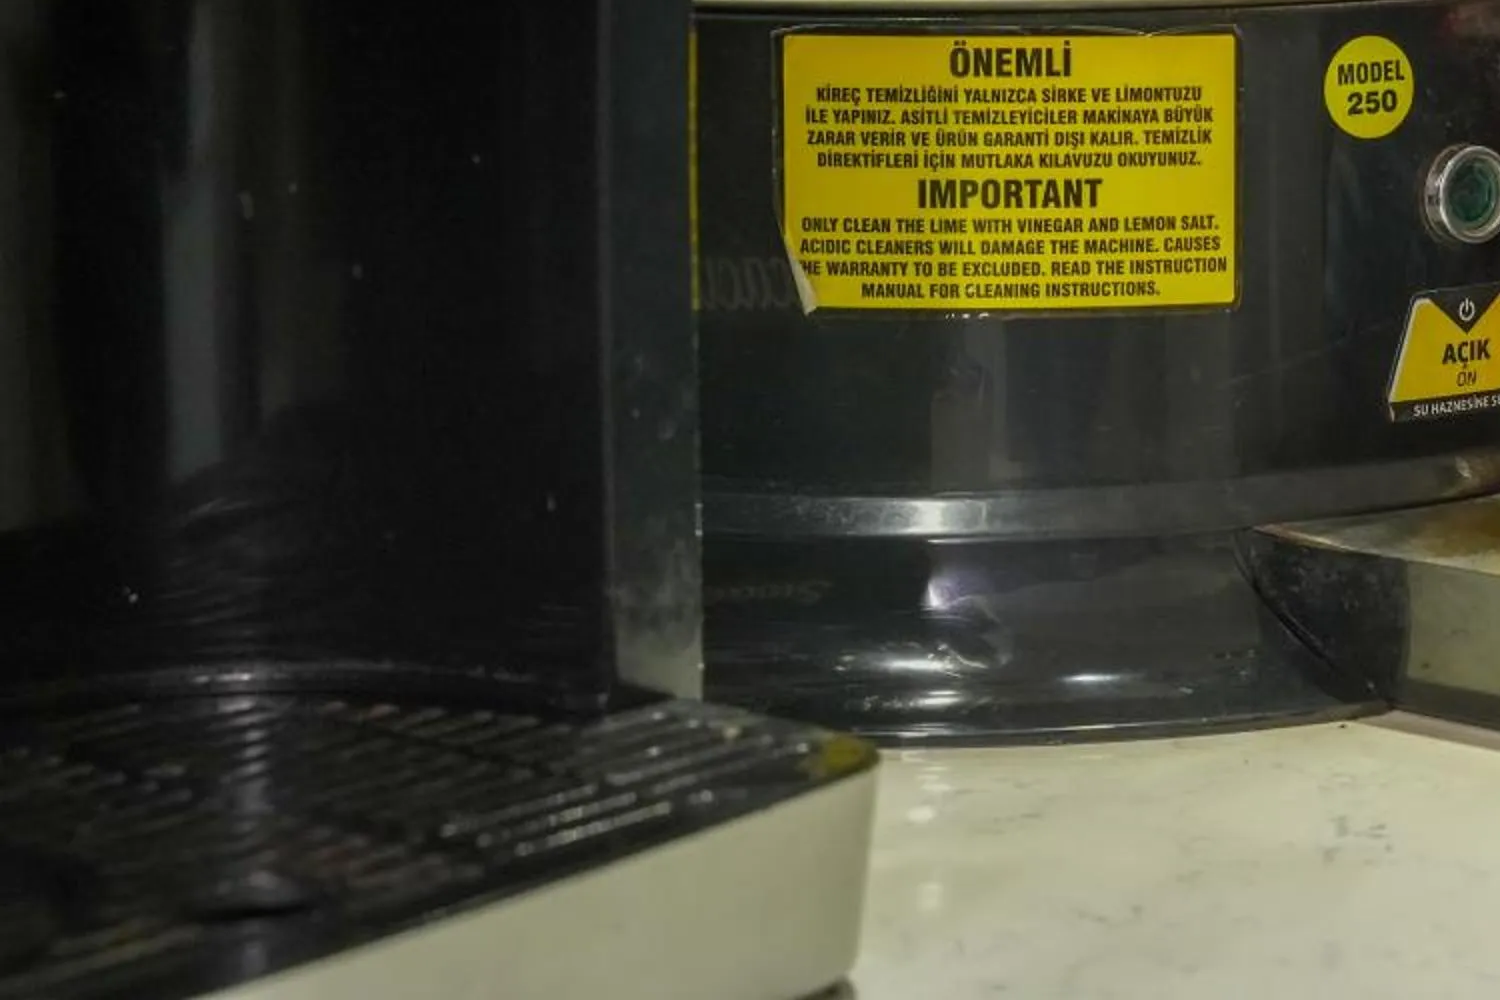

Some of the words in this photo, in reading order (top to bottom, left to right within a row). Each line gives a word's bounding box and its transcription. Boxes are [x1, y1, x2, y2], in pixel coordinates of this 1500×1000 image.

[949, 40, 1072, 78] ÖNEMLİ
[1337, 59, 1405, 86] MODEL
[816, 83, 861, 106] KİREÇ
[865, 84, 959, 103] TEMİZLİĞİNİ
[963, 88, 1037, 104] YALNIZCA
[1041, 84, 1087, 103] SİRKE
[1091, 87, 1111, 103] VE
[1115, 84, 1203, 102] LİMONTUZU
[1346, 88, 1398, 116] 250
[805, 105, 828, 124] İLE
[832, 109, 896, 125] YAPINIZ.
[900, 107, 948, 125] ASİTLİ
[952, 107, 1078, 125] TEMİZLEYİCİLER
[1083, 106, 1159, 124] MAKİNAYA
[1163, 104, 1214, 124] BÜYÜK
[807, 130, 856, 146] ZARAR
[860, 128, 906, 146] VERİR
[910, 131, 931, 146] VE
[935, 128, 978, 147] ÜRÜN
[983, 128, 1049, 147] GARANTİ
[1054, 130, 1085, 149] DIŞI
[1089, 131, 1139, 146] KALIR.
[1143, 127, 1213, 145] TEMİZLİK
[817, 150, 919, 169] DİREKTİFLERİ
[923, 150, 956, 172] İÇİN
[961, 153, 1034, 169] MUTLAKA
[1039, 152, 1113, 168] KILAVUZU
[1117, 151, 1203, 167] OKUYUNUZ.
[917, 178, 1104, 209] IMPORTANT
[801, 217, 838, 233] ONLY
[843, 217, 891, 233] CLEAN
[896, 218, 925, 233] THE
[930, 218, 968, 233] LIME
[972, 218, 1013, 233] WITH
[1017, 217, 1084, 233] VINEGAR
[1088, 217, 1119, 233] AND
[1123, 216, 1177, 232] LEMON
[1180, 214, 1220, 231] SALT.
[800, 238, 851, 255] ACIDIC
[855, 239, 934, 255] CLEANERS
[938, 239, 976, 255] WILL
[980, 239, 1045, 255] DAMAGE
[1049, 239, 1079, 254] THE
[1083, 238, 1160, 254] MACHINE.
[1163, 236, 1221, 252] CAUSES
[825, 260, 909, 276] WARRANTY
[913, 261, 933, 276] TO
[937, 261, 957, 276] BE
[962, 260, 1046, 277] EXCLUDED.
[1050, 260, 1092, 276] READ
[1096, 259, 1125, 275] THE
[1129, 257, 1228, 275] INSTRUCTION
[861, 283, 925, 299] MANUAL
[929, 283, 960, 299] FOR
[964, 283, 1041, 298] CLEANING
[1045, 281, 1161, 297] INSTRUCTIONS.
[1441, 338, 1491, 368] AÇIK
[1456, 370, 1478, 387] ON
[1412, 404, 1429, 418] SU
